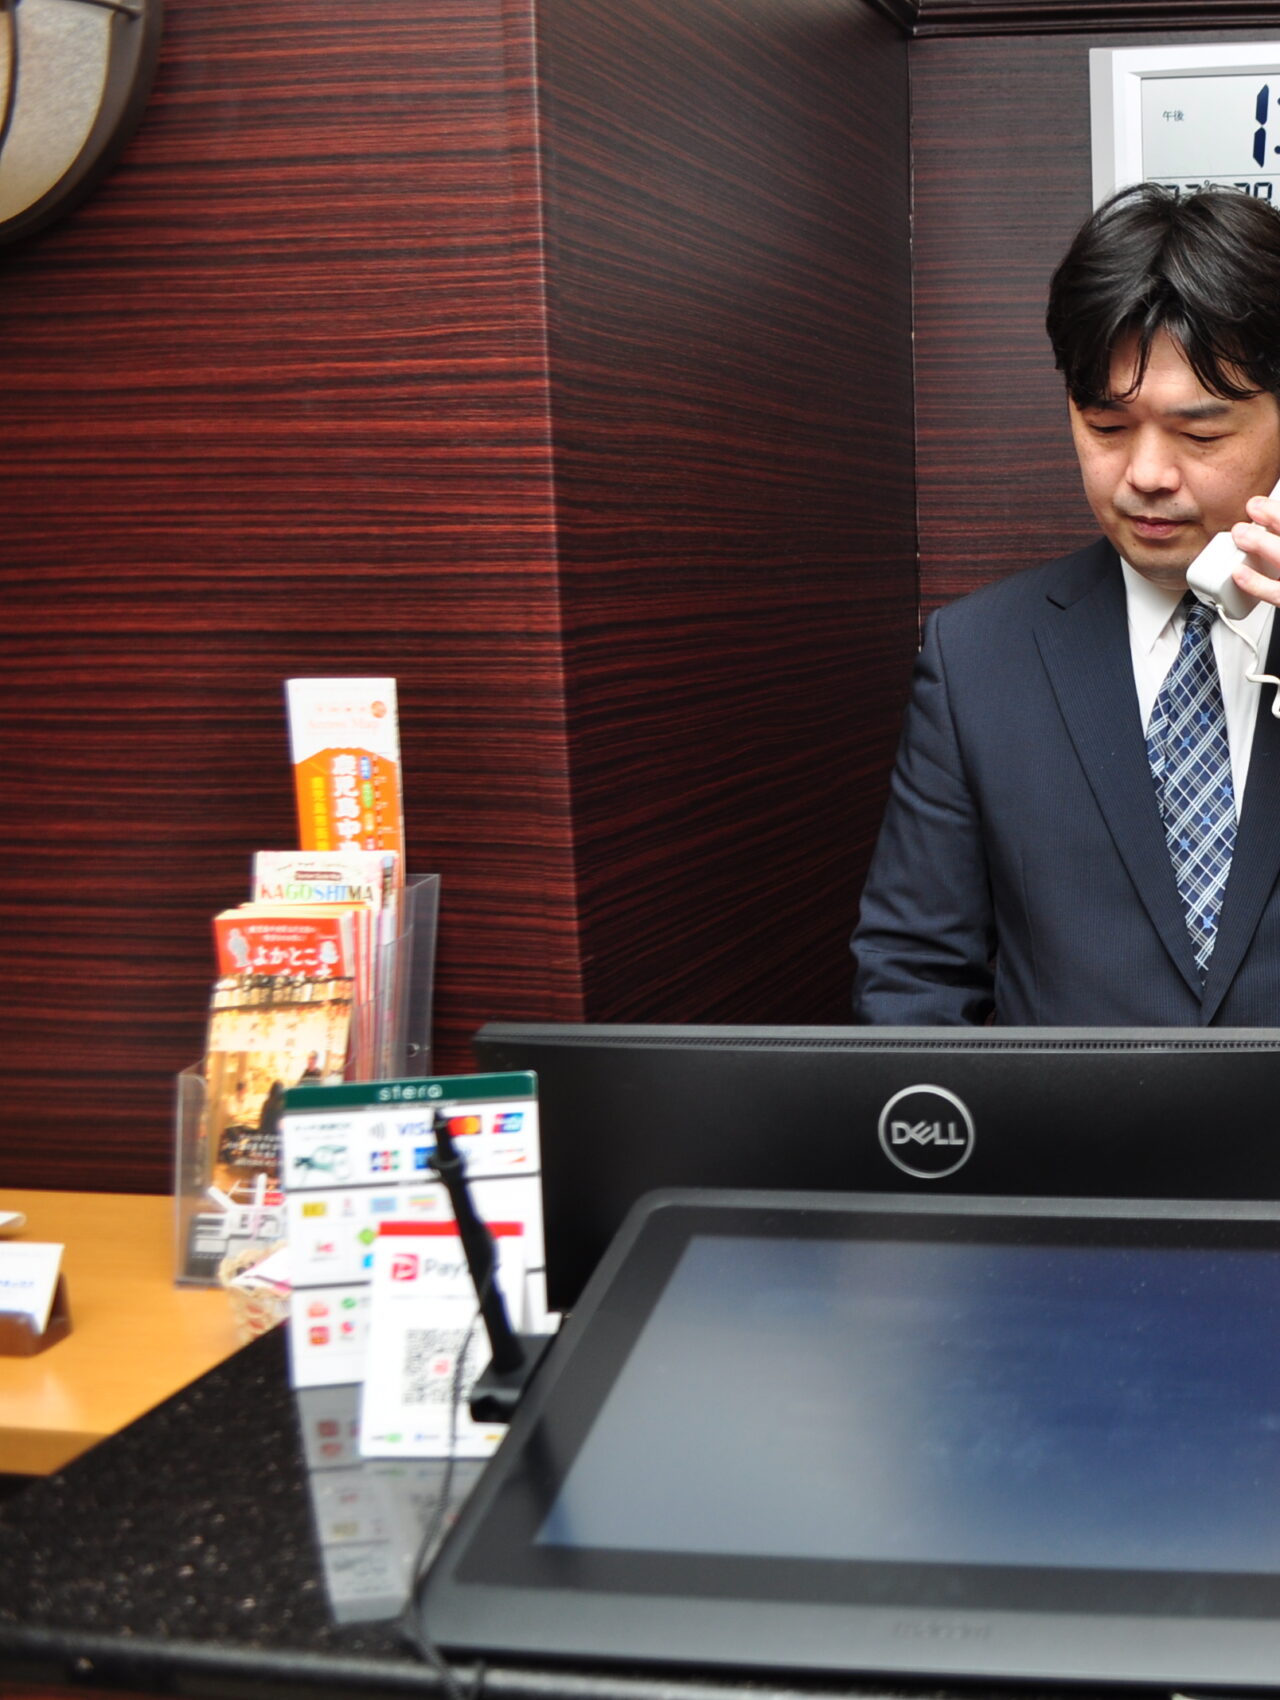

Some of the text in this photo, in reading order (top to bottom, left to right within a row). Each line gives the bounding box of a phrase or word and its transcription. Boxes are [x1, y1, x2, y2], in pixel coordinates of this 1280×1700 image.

[1162, 110, 1185, 122] 午後
[260, 884, 374, 901] KAGOSHIMA
[890, 1120, 966, 1146] DELL
